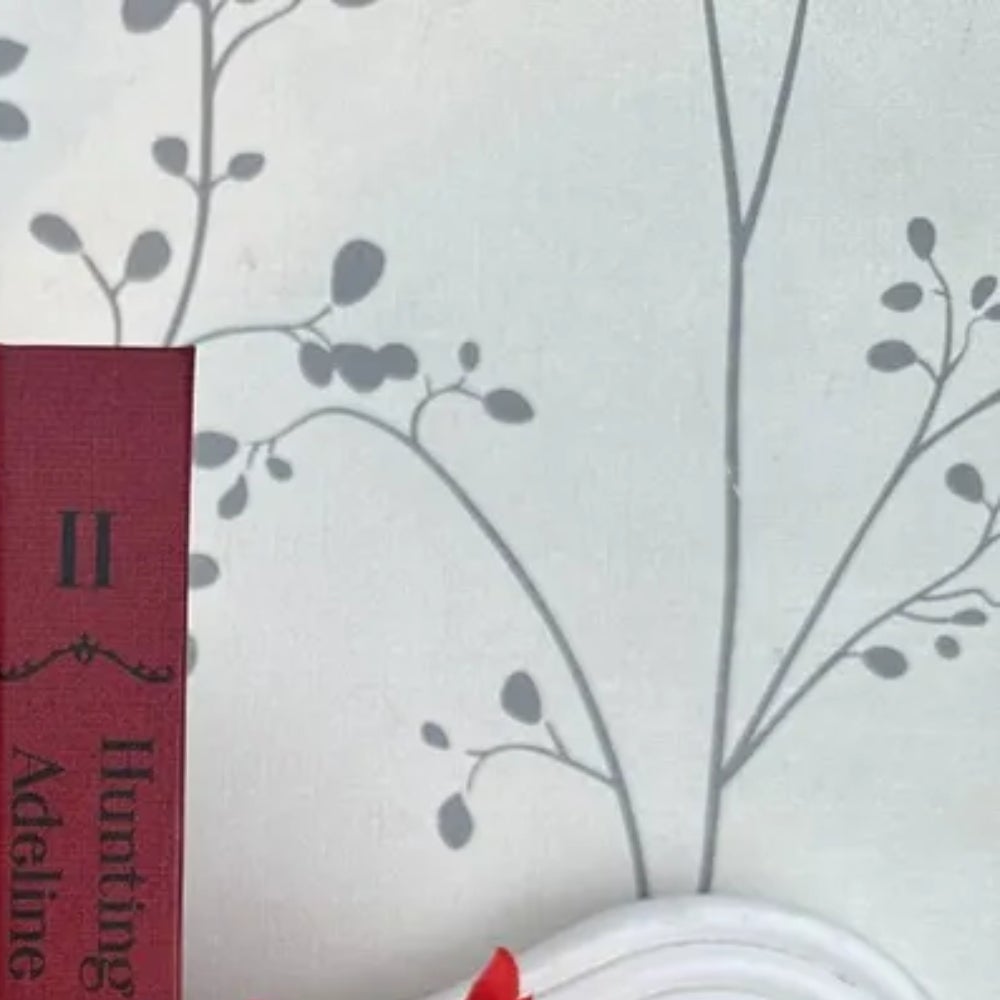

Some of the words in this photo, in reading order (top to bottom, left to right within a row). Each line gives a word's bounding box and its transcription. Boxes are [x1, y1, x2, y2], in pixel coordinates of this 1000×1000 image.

[57, 510, 118, 589] II
[7, 747, 66, 981] Adeline
[78, 737, 155, 998] Hunting
